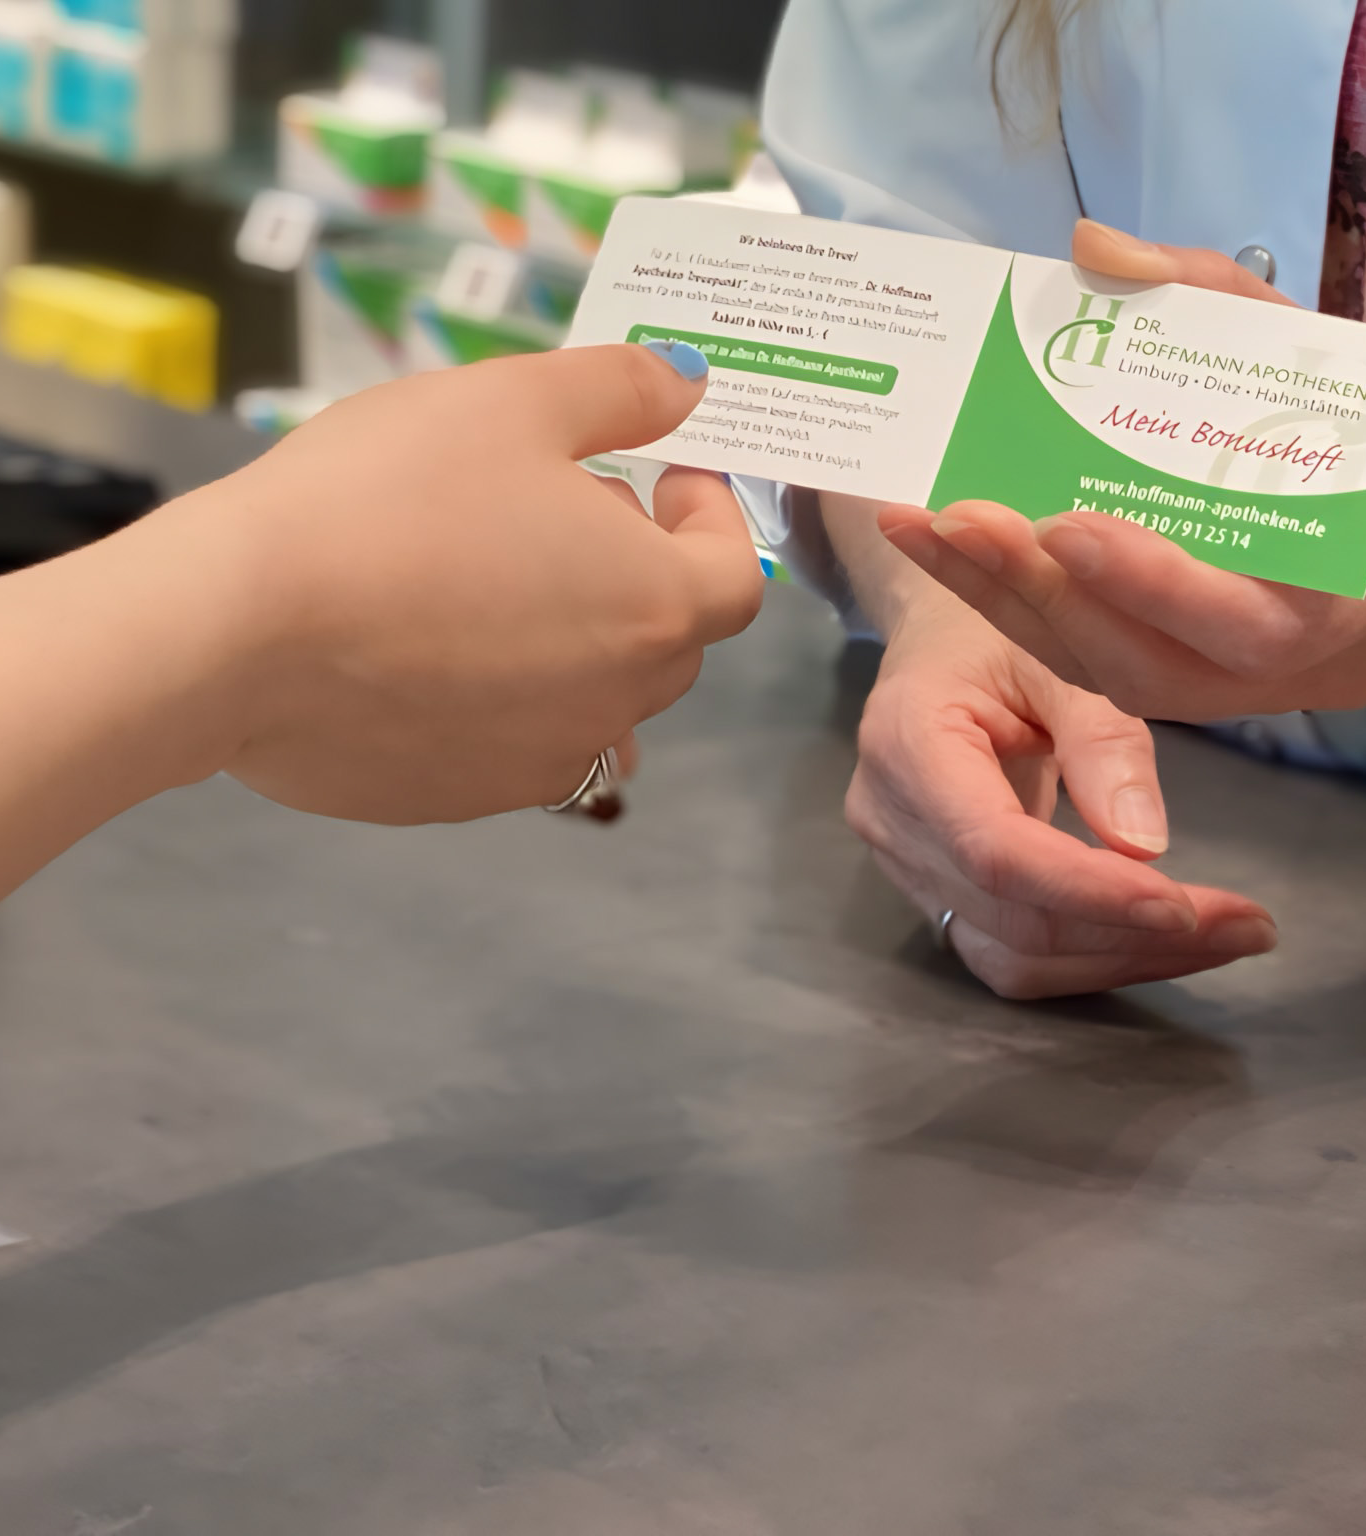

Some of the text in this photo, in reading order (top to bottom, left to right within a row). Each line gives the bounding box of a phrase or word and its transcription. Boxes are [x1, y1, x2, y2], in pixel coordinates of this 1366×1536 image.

[1125, 337, 1244, 375] HOFFMANN
[1133, 316, 1166, 336] DR.
[1117, 357, 1189, 389] Limburg
[1254, 386, 1362, 421] Hahnstätten
[1099, 404, 1347, 483] Mein Bonusheft
[1079, 475, 1327, 538] www.hoffmann-apotheken.de
